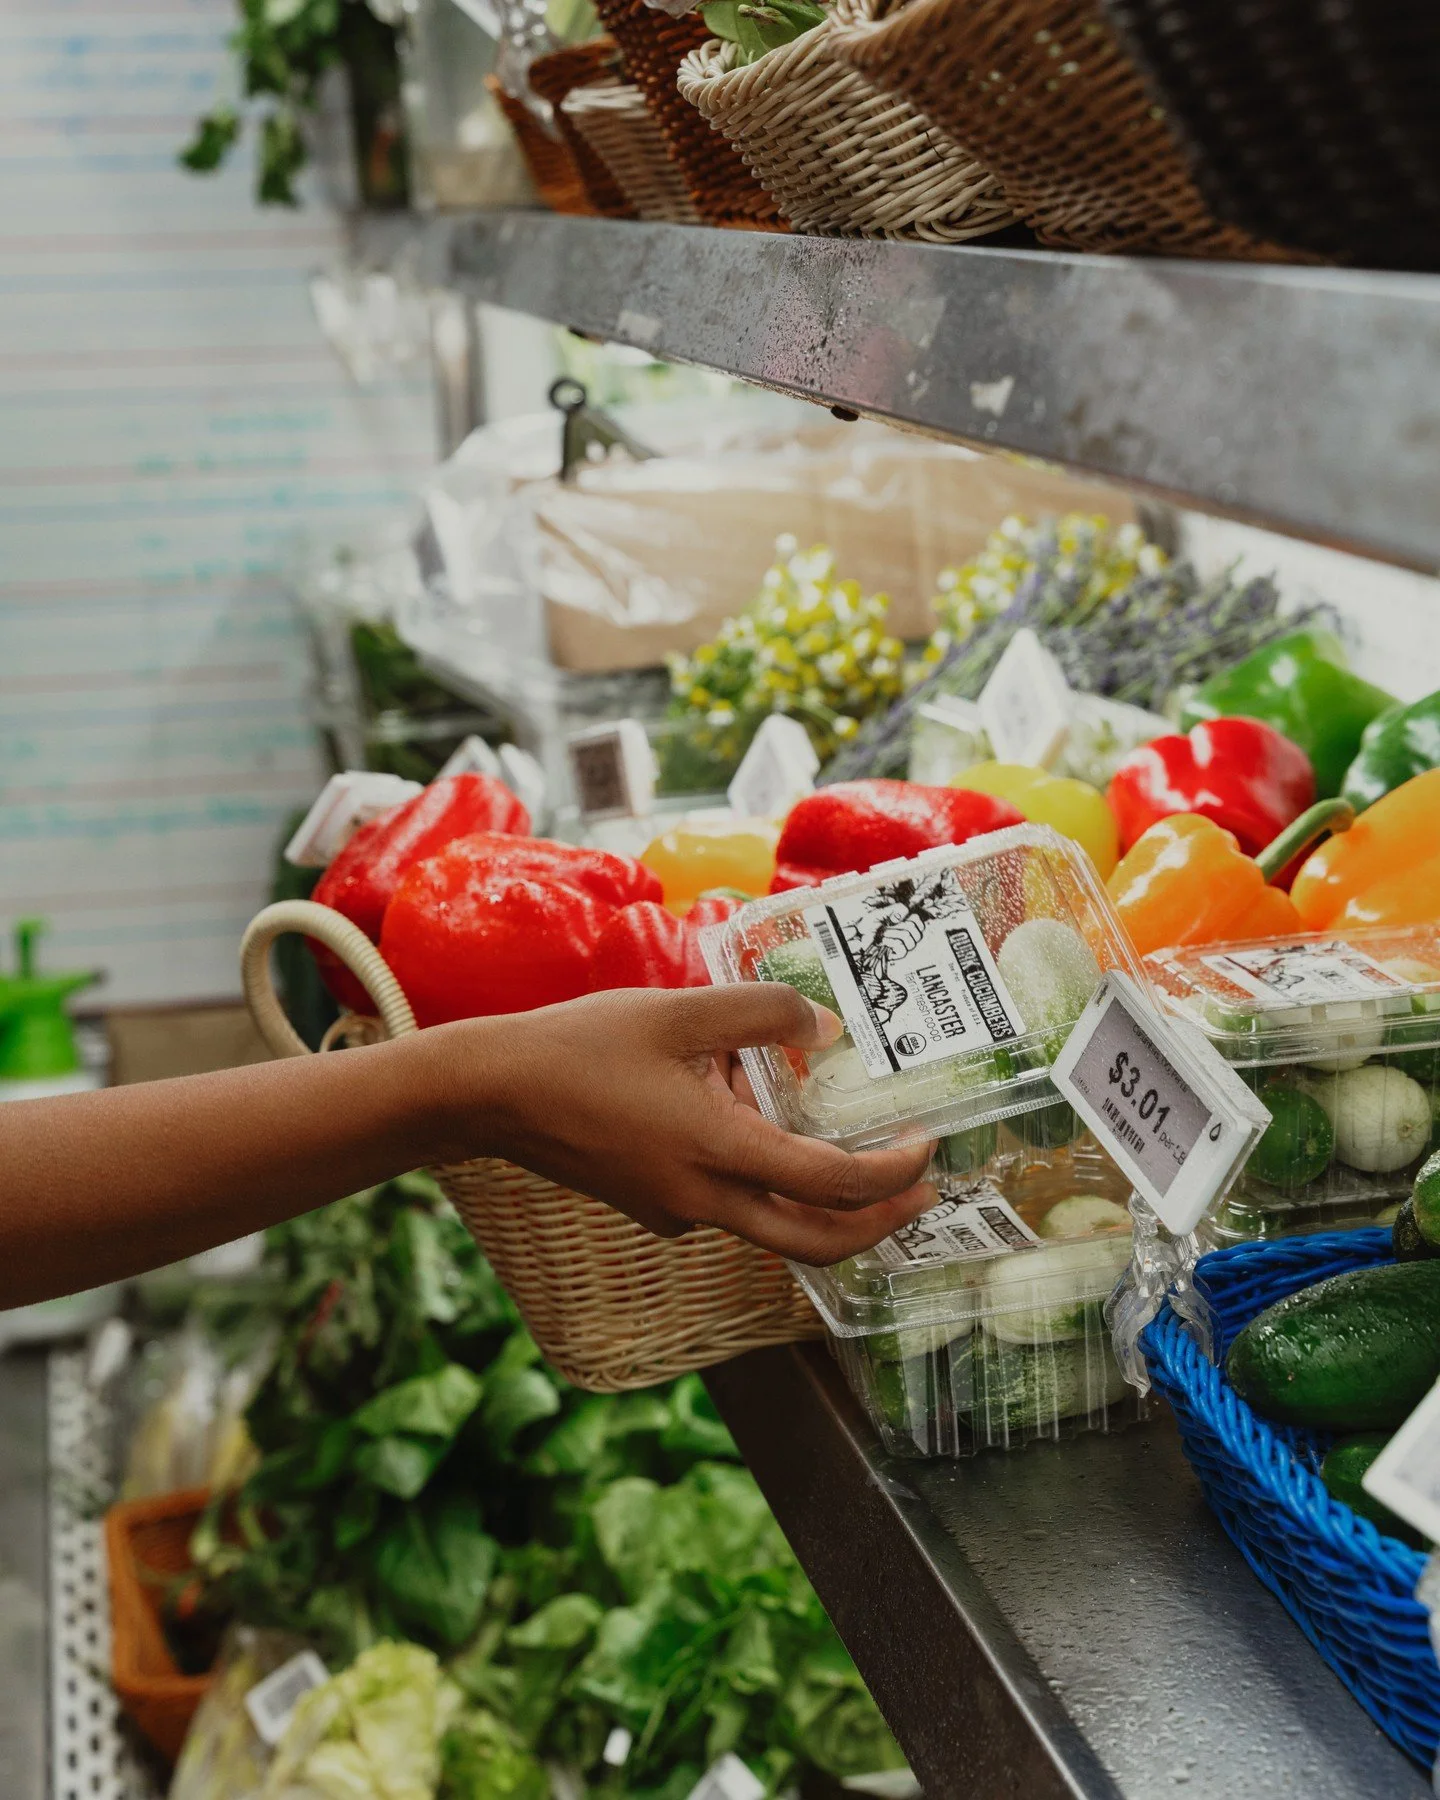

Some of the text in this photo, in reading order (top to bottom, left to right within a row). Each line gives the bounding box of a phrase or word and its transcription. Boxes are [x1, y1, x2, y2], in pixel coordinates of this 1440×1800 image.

[914, 992, 931, 1016] fresh
[923, 1016, 942, 1043] co-op
[915, 964, 966, 1039] LANCASTER
[965, 968, 1013, 1039] CUCUMBERS
[1108, 1051, 1171, 1134] $3.01
[1158, 1131, 1175, 1151] per
[945, 1222, 988, 1251] LANCASTE
